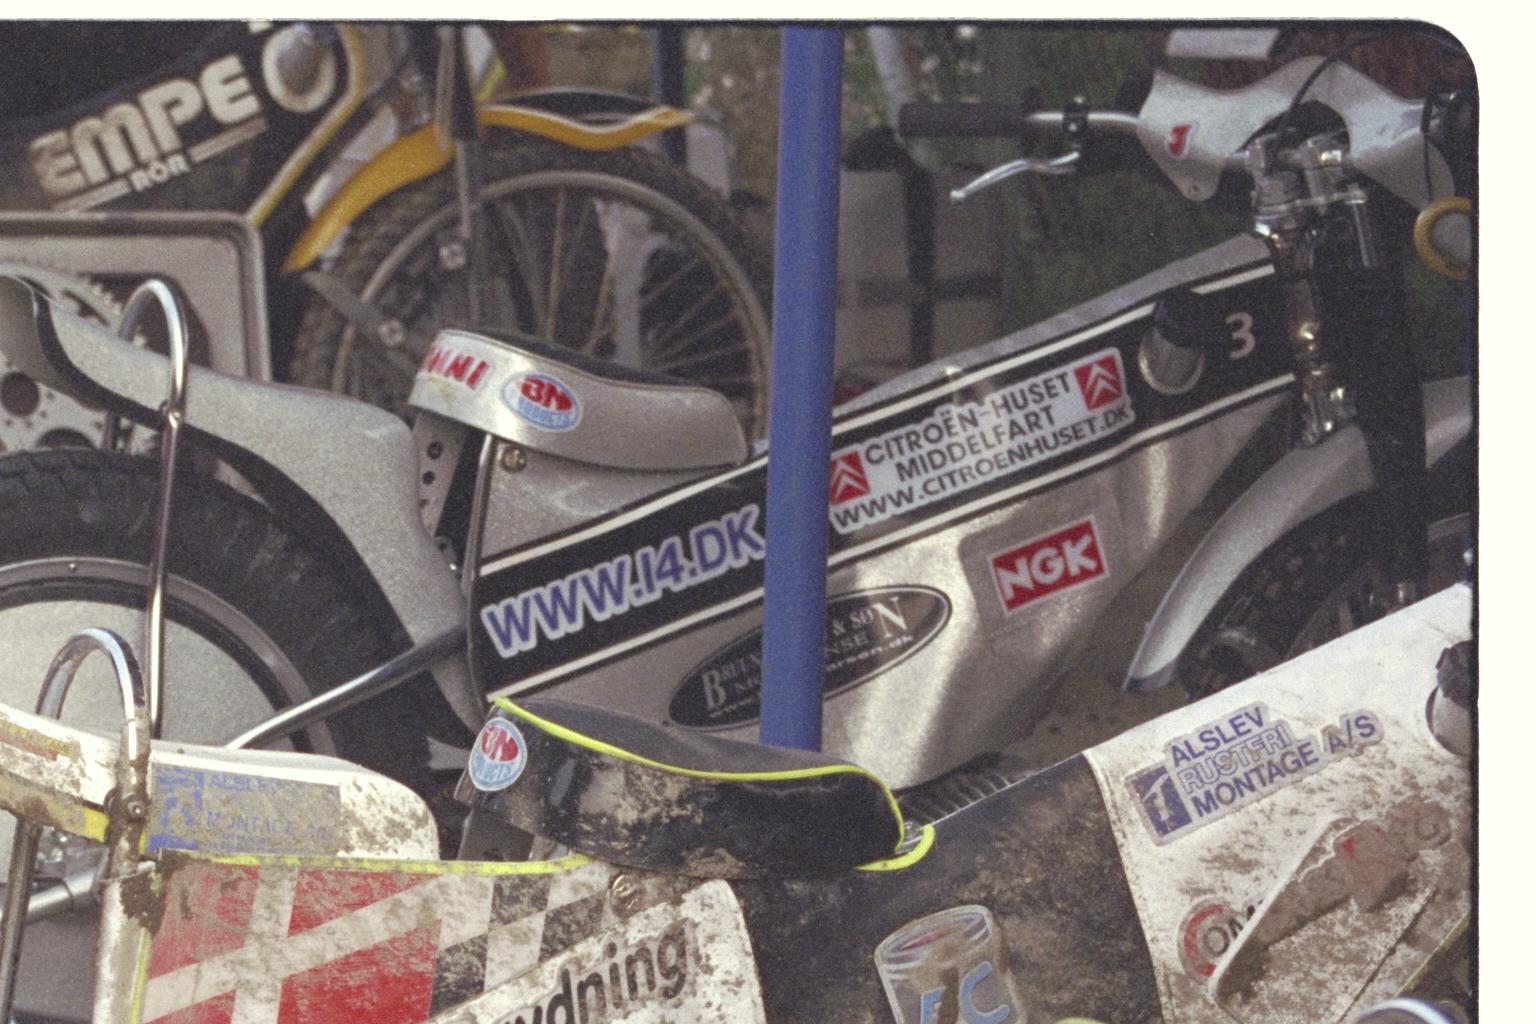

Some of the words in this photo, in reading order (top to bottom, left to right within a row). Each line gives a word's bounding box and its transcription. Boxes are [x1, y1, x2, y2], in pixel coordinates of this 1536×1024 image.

[30, 55, 262, 194] EMPE
[1167, 123, 1191, 156] 3
[1225, 312, 1256, 358] 3
[865, 371, 1072, 466] CITROËN-HUSET
[895, 405, 1057, 483] MIDDELFART
[834, 407, 1130, 528] WWW.CITROENHUSET.DK
[997, 532, 1103, 606] NGK
[1170, 705, 1266, 768] ALSLEV
[1189, 742, 1321, 819] MONTAGE
[1328, 714, 1378, 754] A/S
